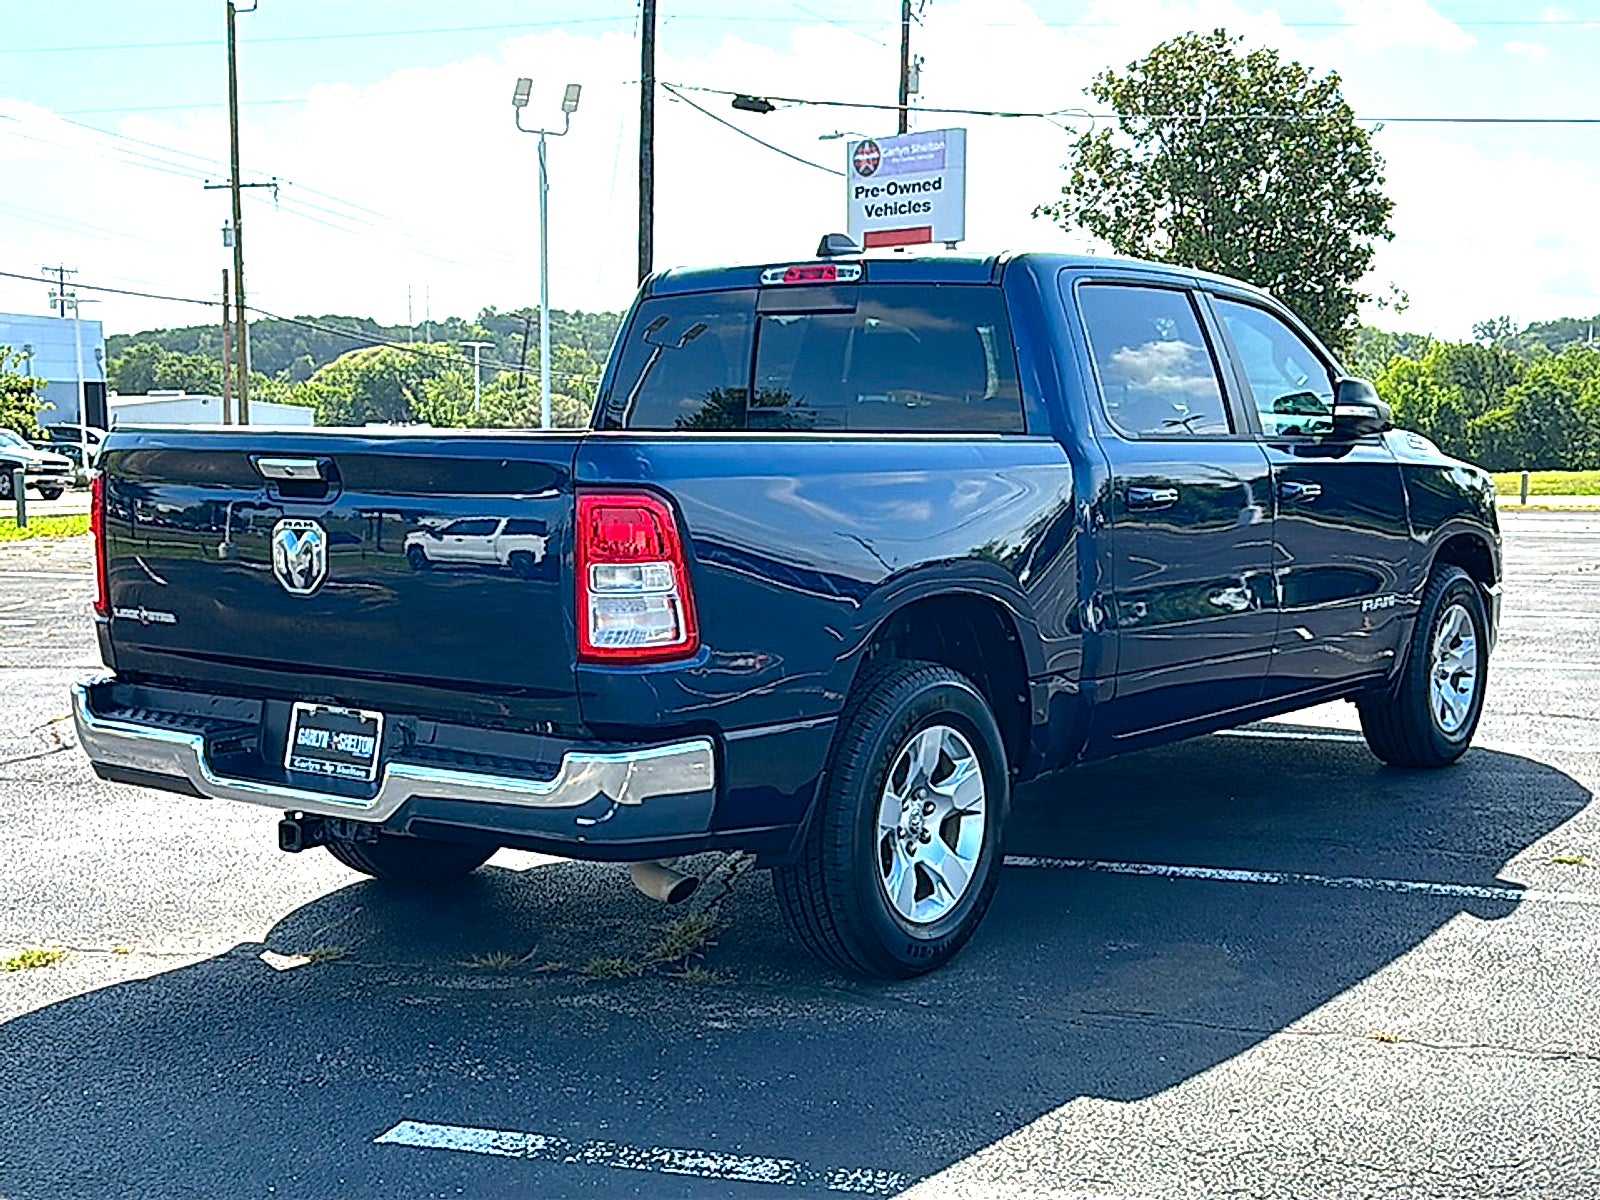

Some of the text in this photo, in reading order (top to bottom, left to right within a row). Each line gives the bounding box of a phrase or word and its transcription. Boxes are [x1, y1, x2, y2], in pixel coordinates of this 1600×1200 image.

[854, 177, 942, 199] Pre-Owned
[864, 200, 932, 217] Vehicles
[1361, 595, 1395, 612] RAM
